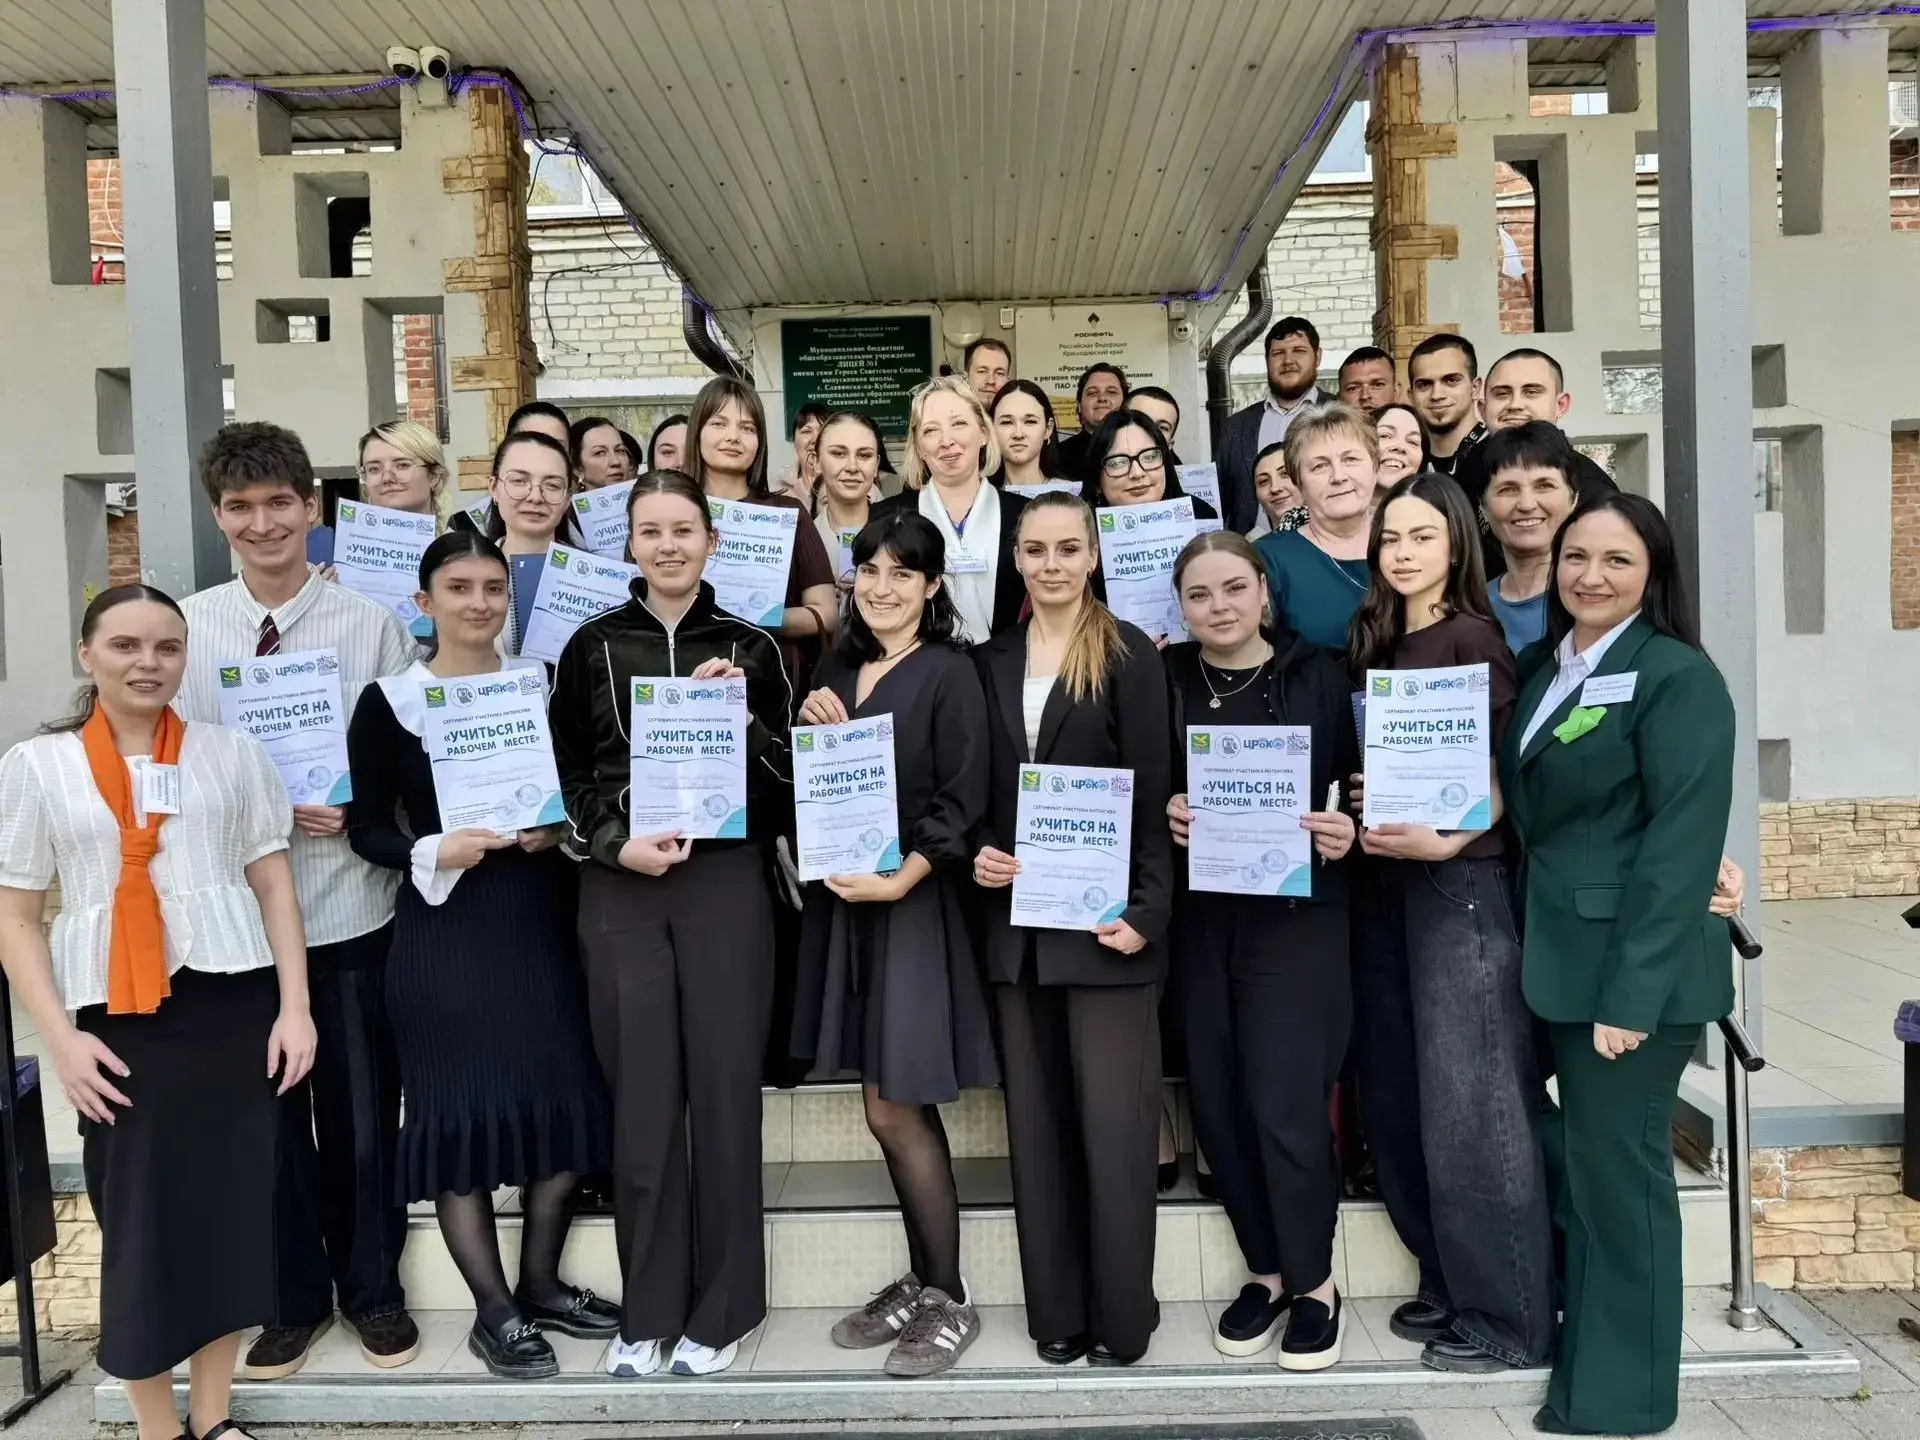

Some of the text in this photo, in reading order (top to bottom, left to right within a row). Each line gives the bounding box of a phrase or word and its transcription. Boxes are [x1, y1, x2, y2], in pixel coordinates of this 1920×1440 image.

[810, 344, 904, 354] Муниципальное бюджетное
[1094, 341, 1127, 349] Федерация
[799, 354, 873, 362] общеобразовательное
[837, 360, 865, 368] ЛИЦЕЙ
[835, 368, 858, 376] Героев
[824, 383, 900, 391] Славянска-на-Кубани
[807, 392, 865, 400] муниципального
[827, 398, 890, 406] Славянский район
[597, 534, 625, 547] РАБОЧЕ
[719, 539, 783, 556] УЧИТЬСЯ НА
[346, 543, 421, 562] «УЧИТЬСЯ НА
[716, 550, 749, 561] АБОЧЕМ
[1113, 548, 1168, 565] «УЧИТЬСЯ
[346, 555, 420, 572] РАБОЧЕМ МЕСТЕ
[1115, 563, 1155, 577] РАБОЧЕМ
[551, 590, 610, 612] «УЧИТЬСЯ
[548, 602, 591, 618] РАБОЧЕМ
[239, 700, 331, 723] «УЧИТЬСЯ НА
[244, 714, 334, 736] АБОЧЕМ МЕСТЕ»
[443, 719, 536, 743] «УЧИТЬСЯ НА
[1382, 718, 1477, 733] «УЧИТЬСЯ НА
[645, 730, 734, 743] «УЧИТЬСЯ НА
[1383, 734, 1479, 745] РАБОЧЕМ МЕСТЕ»
[447, 734, 540, 756] РАБОЧЕМ МЕСТЕ»
[646, 745, 735, 755] РАБОЧЕМ МЕСТЕ»
[808, 765, 886, 786] «УЧИТЬСЯ НА
[809, 780, 888, 799] РАБОЧЕМ МЕСТЕ»
[1202, 781, 1296, 794] «УЧИТЬСЯ НА
[1203, 797, 1298, 808] РАБОЧЕМ МЕСТЕ»
[1030, 817, 1117, 834] «УЧИТЬСЯ НА
[1030, 832, 1118, 847] РАБОЧЕМ МЕСТЕ»
